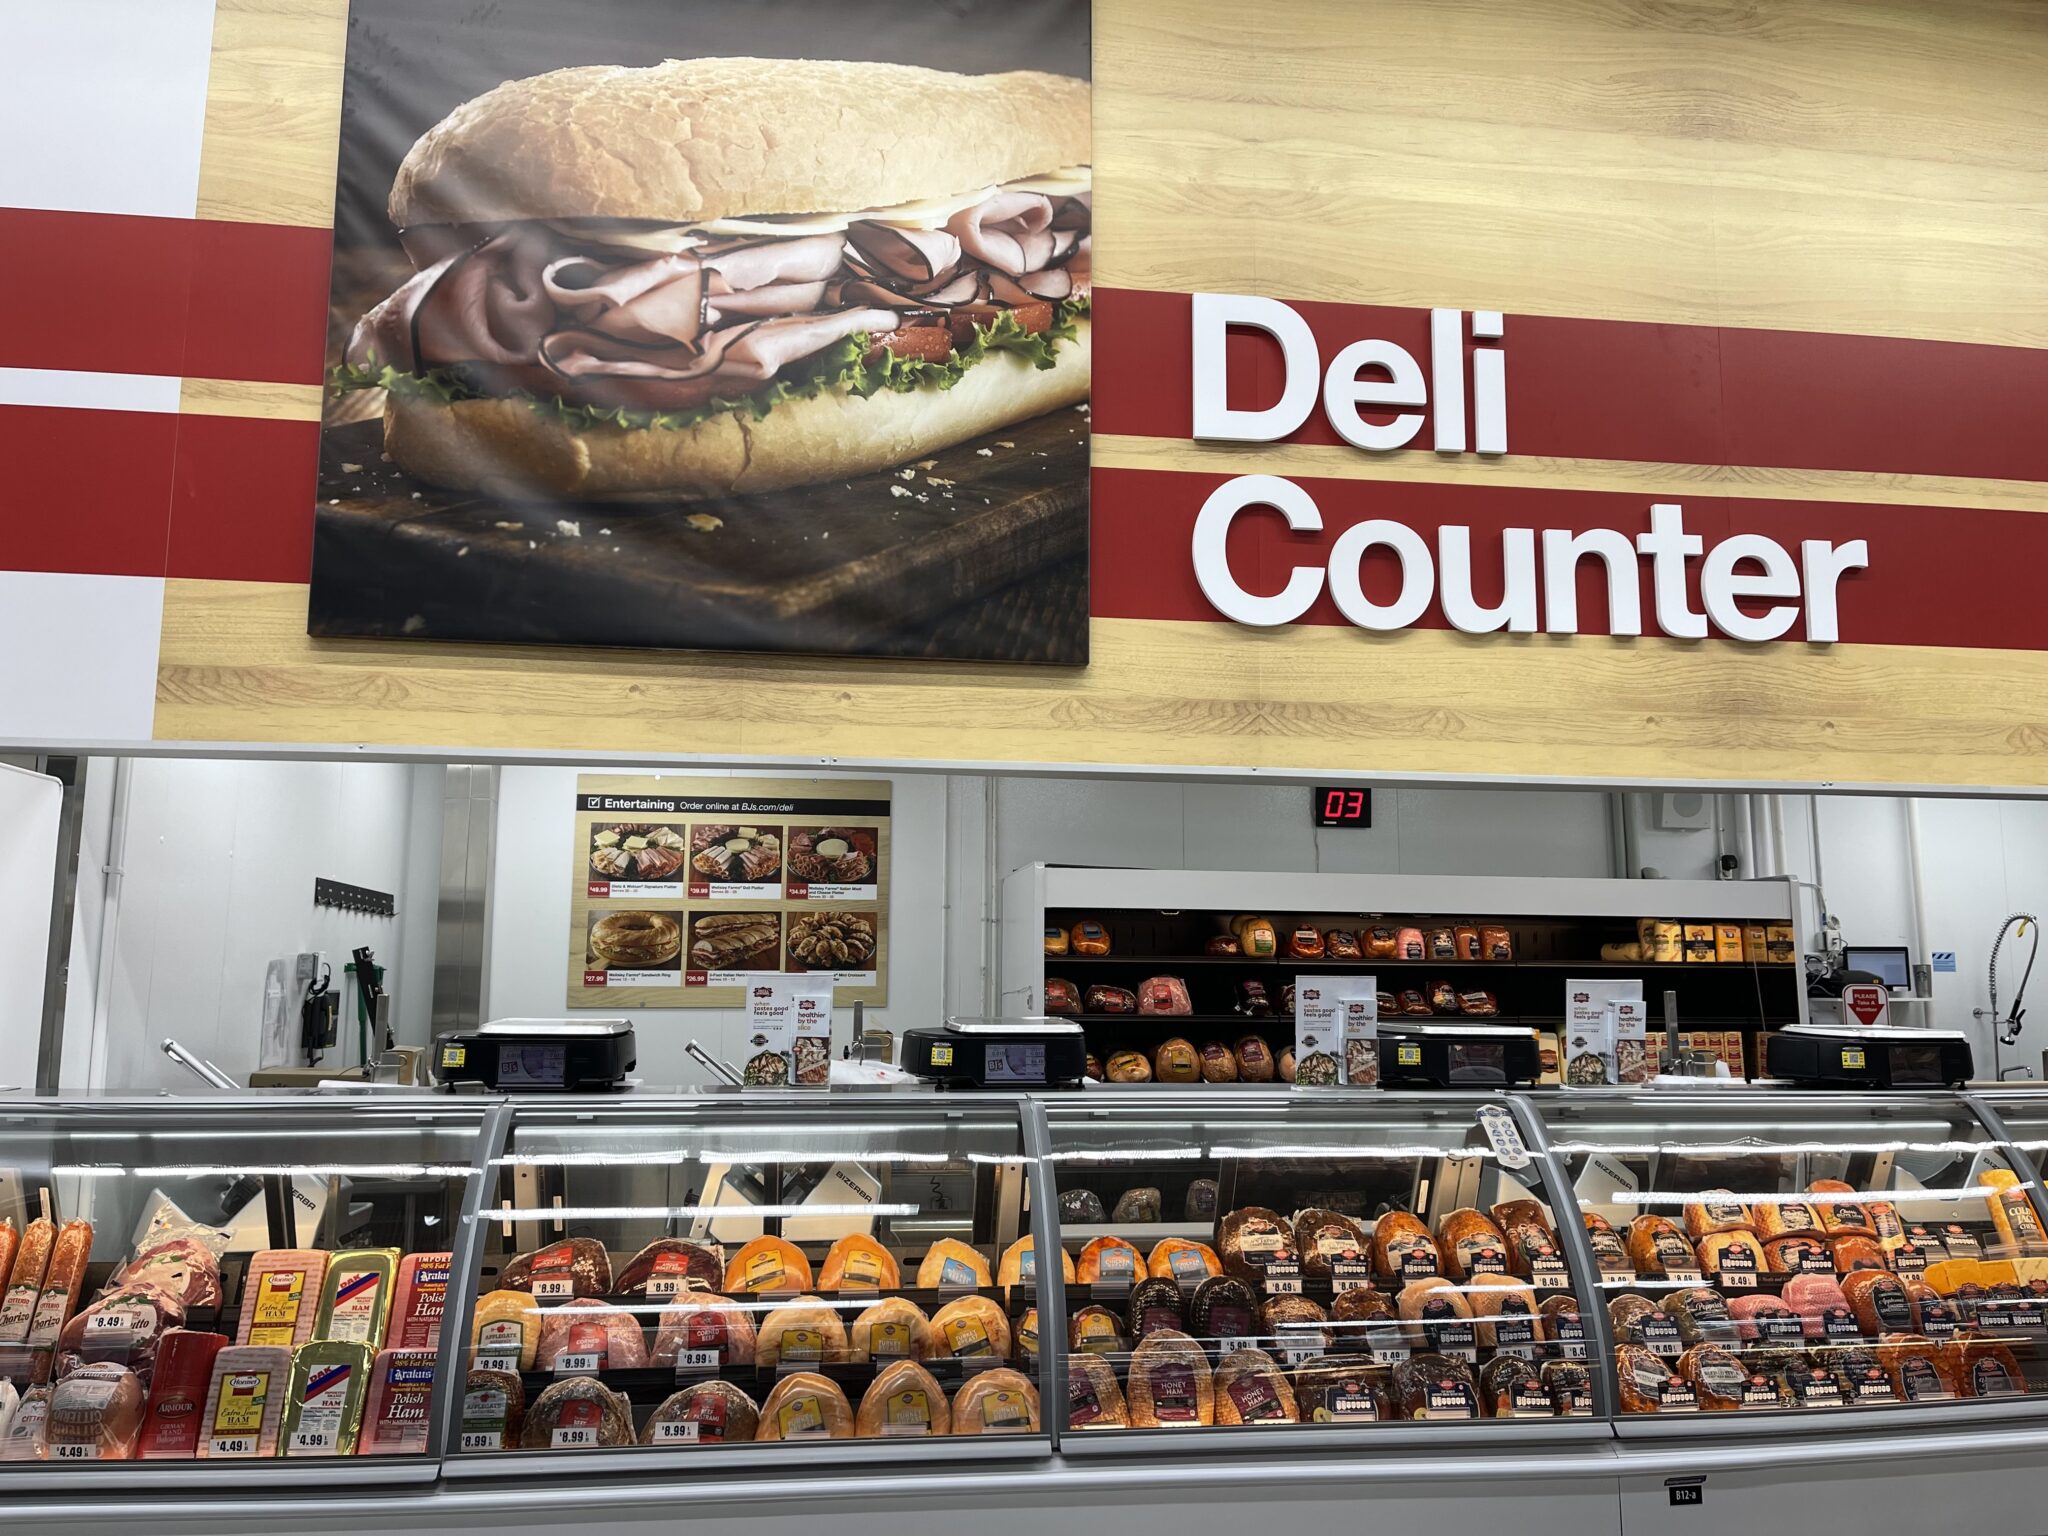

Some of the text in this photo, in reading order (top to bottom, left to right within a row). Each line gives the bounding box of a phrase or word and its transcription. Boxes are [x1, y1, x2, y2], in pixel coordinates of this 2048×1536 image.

[1191, 293, 1507, 455] Deli
[1191, 474, 1868, 643] Counter
[604, 798, 675, 812] Entertaining
[680, 802, 703, 810] Order
[705, 803, 730, 811] online
[741, 803, 794, 812] BJs.com/deli
[1324, 791, 1364, 818] 03
[1594, 1160, 1633, 1190] BIZERBA
[835, 1170, 873, 1203] BIZERBA
[339, 1273, 361, 1289] DAK
[420, 1270, 450, 1282] Kraku
[539, 1284, 561, 1293] $8.99
[653, 1282, 675, 1292] $8.99
[95, 1316, 120, 1327] $8.49
[562, 1357, 586, 1369] $8.99
[684, 1353, 707, 1364] $8.99
[309, 1365, 333, 1383] DAK
[1161, 1381, 1187, 1390] HONEY
[393, 1392, 424, 1404] Polish
[1241, 1386, 1266, 1402] HONEY
[1247, 1394, 1265, 1407] HAM
[158, 1403, 193, 1413] ARMOUR
[220, 1407, 240, 1417] Extra
[386, 1404, 425, 1419] Ham
[227, 1415, 250, 1424] HAM
[559, 1431, 584, 1443] $8.99
[661, 1425, 686, 1437] $8.99
[216, 1440, 243, 1452] $4.49
[297, 1434, 323, 1446] $4.99
[462, 1435, 487, 1447] $8.99
[56, 1446, 83, 1458] $4.49
[1675, 1490, 1697, 1501] B12-a
